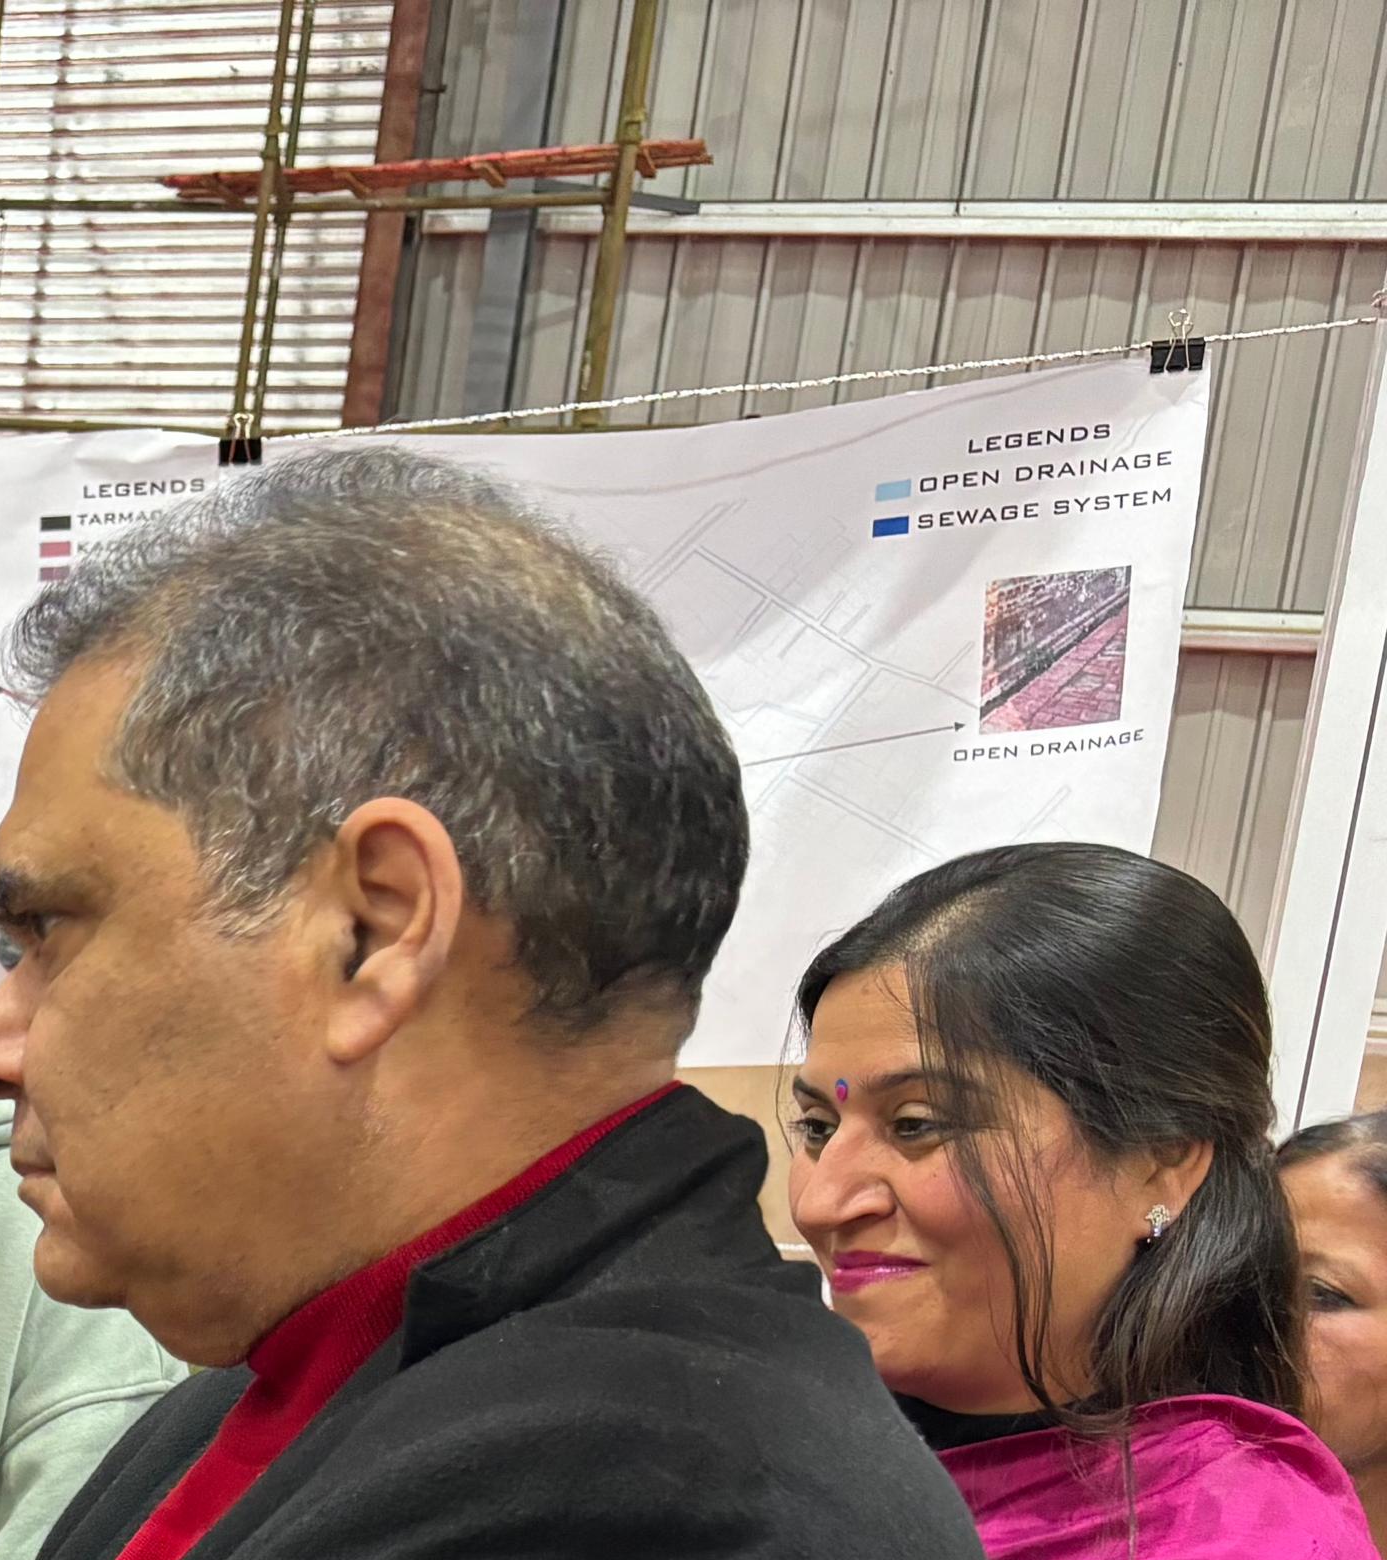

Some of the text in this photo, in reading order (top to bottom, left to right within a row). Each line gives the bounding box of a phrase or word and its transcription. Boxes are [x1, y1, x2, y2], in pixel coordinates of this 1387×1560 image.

[968, 424, 1111, 454] LEGENDS
[83, 478, 205, 499] LEGENDS
[919, 451, 1172, 493] OPEN DRAINAGE
[918, 487, 1172, 529] SEWAGE SYSTEM
[953, 728, 1145, 762] OPEN DRAINAGE
